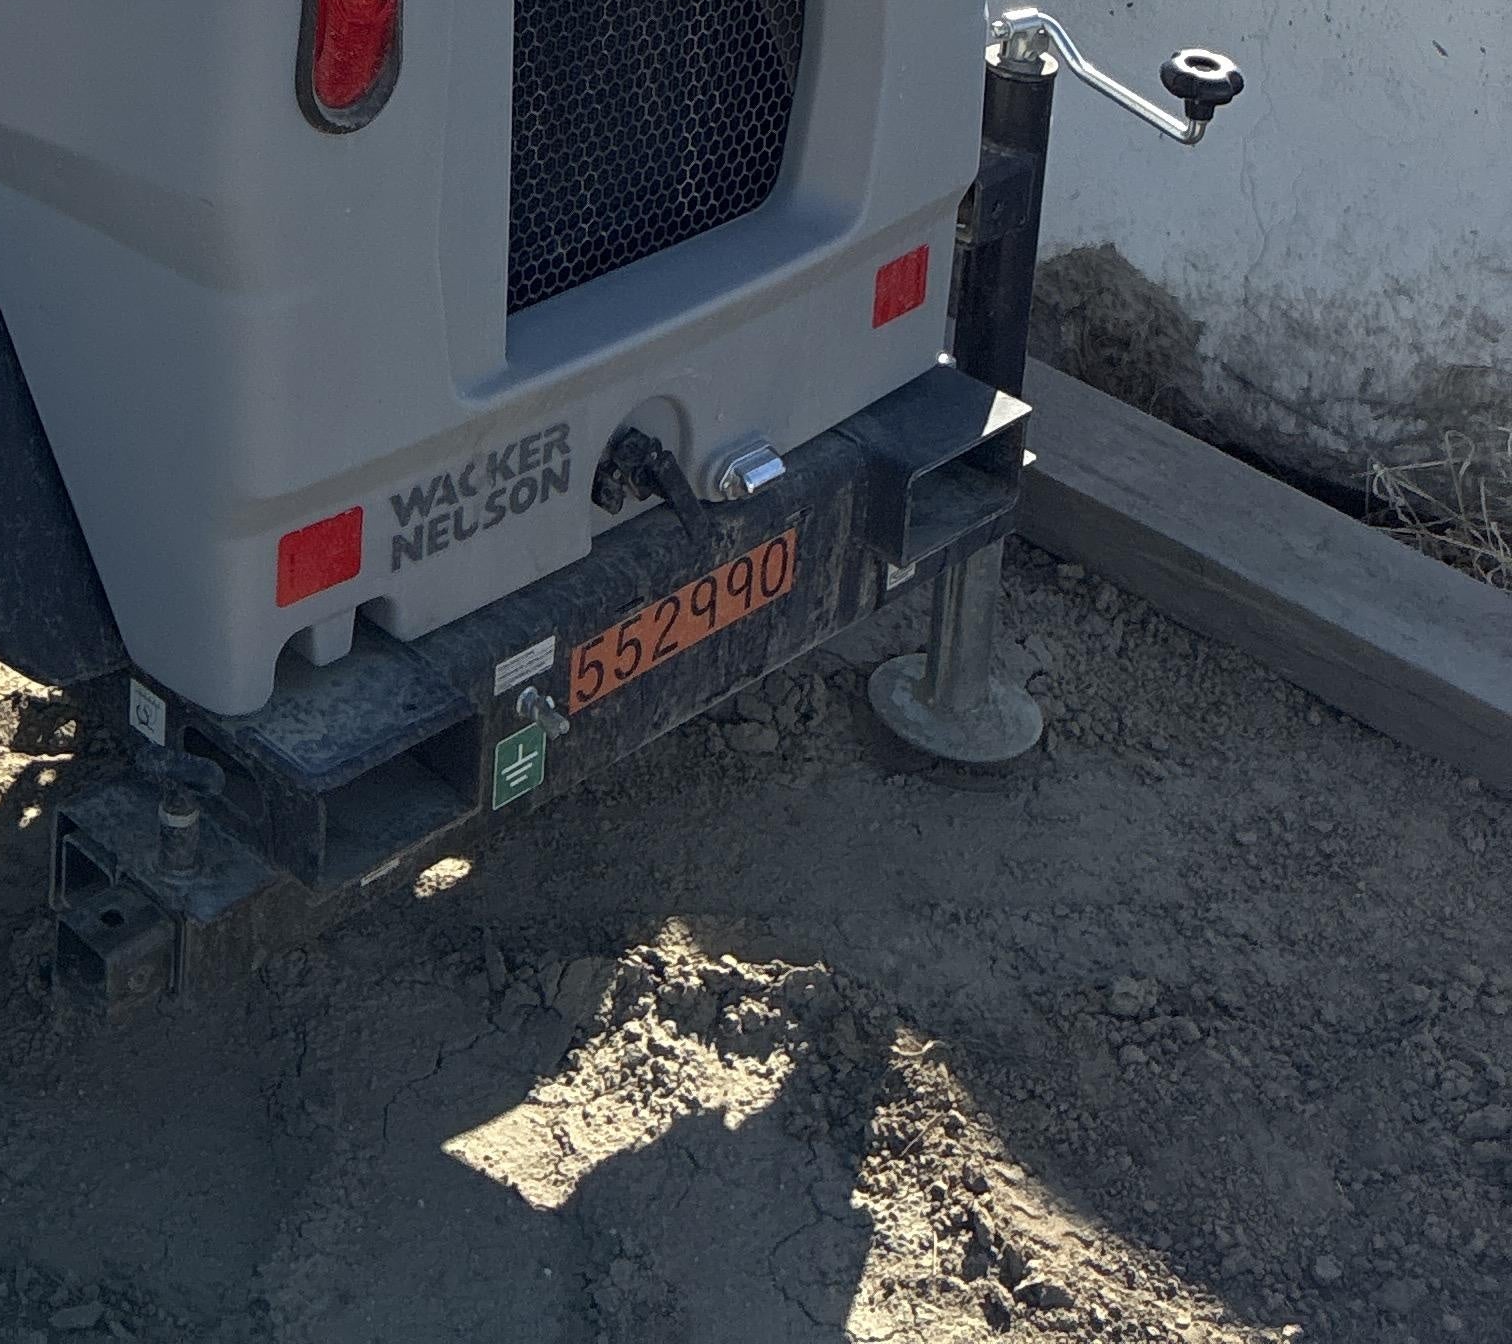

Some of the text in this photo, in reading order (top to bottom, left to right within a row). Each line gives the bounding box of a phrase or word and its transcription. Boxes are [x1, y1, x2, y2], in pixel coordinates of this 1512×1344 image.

[390, 422, 572, 528] WACKER
[390, 459, 571, 573] NEUSON
[575, 535, 789, 704] 552990
